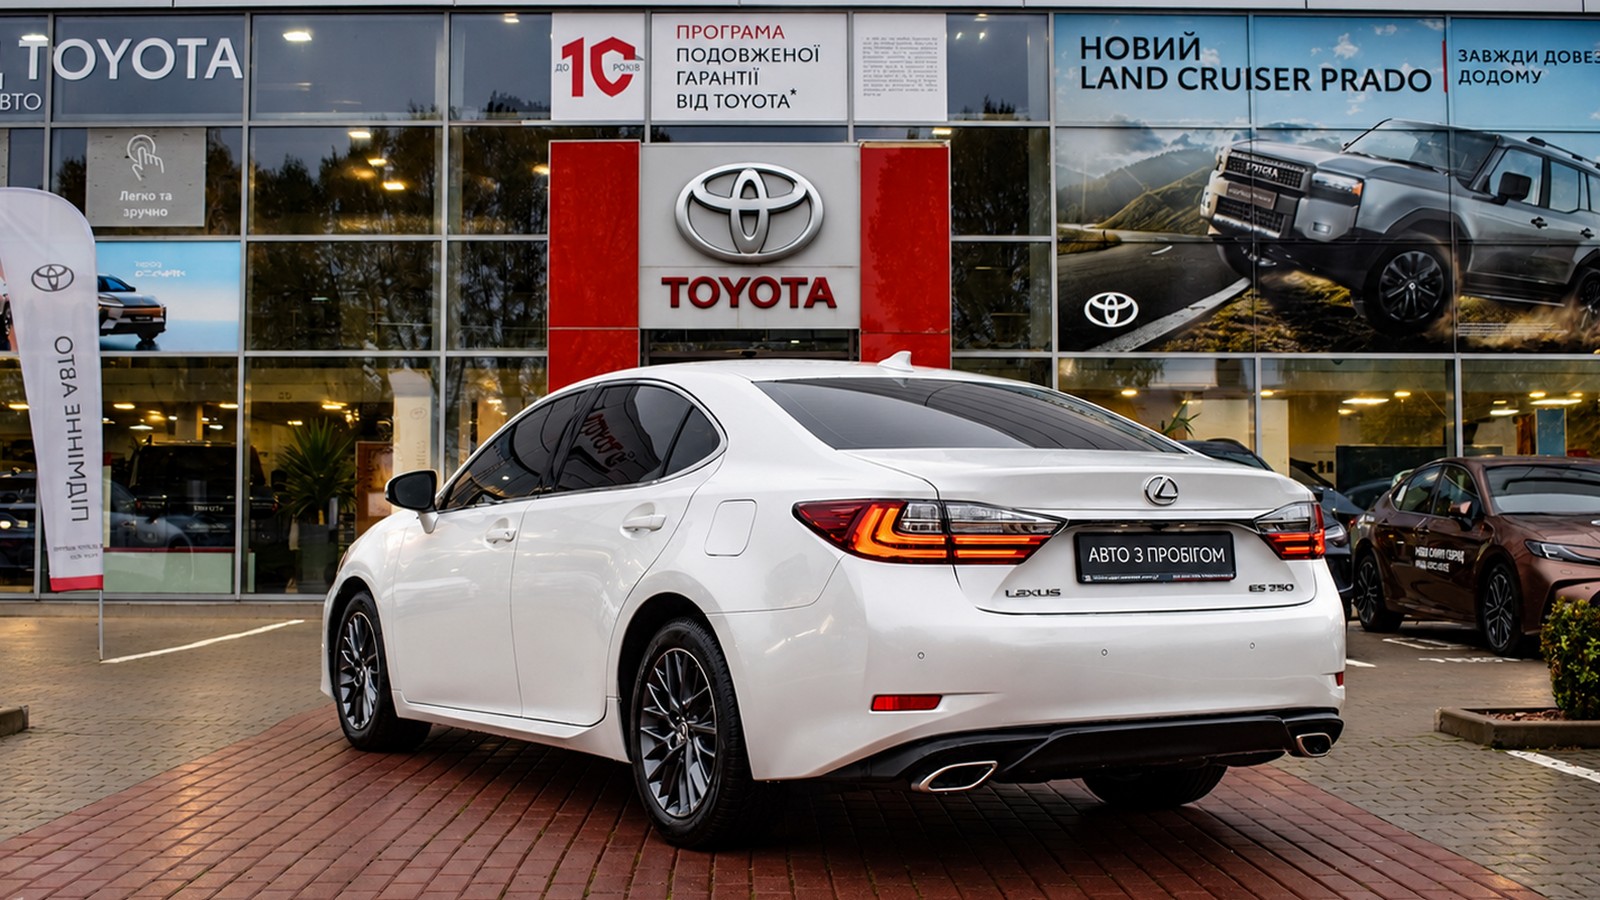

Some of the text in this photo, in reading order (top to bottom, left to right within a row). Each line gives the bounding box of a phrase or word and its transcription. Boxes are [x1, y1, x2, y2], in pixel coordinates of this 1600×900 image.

[676, 24, 785, 40] ПРОГРАМА
[676, 44, 821, 64] ПОДОВЖЕНОЇ
[1080, 31, 1200, 61] НОВИЙ
[18, 37, 243, 80] TOYOTA
[1458, 49, 1538, 66] ЗАВЖДИ
[555, 63, 570, 73] ДО
[613, 63, 641, 72] РОКІВ
[676, 67, 760, 86] ГАРАНТІЇ
[1080, 65, 1432, 92] LAND CRUISER PRADO
[1458, 70, 1542, 86] ДОДОМУ
[676, 94, 708, 111] ВІД
[119, 190, 173, 201] Легко та
[123, 208, 168, 219] зручно
[661, 276, 837, 309] TOYOTA
[1088, 547, 1226, 563] АВТО З ПРОБІГОМ
